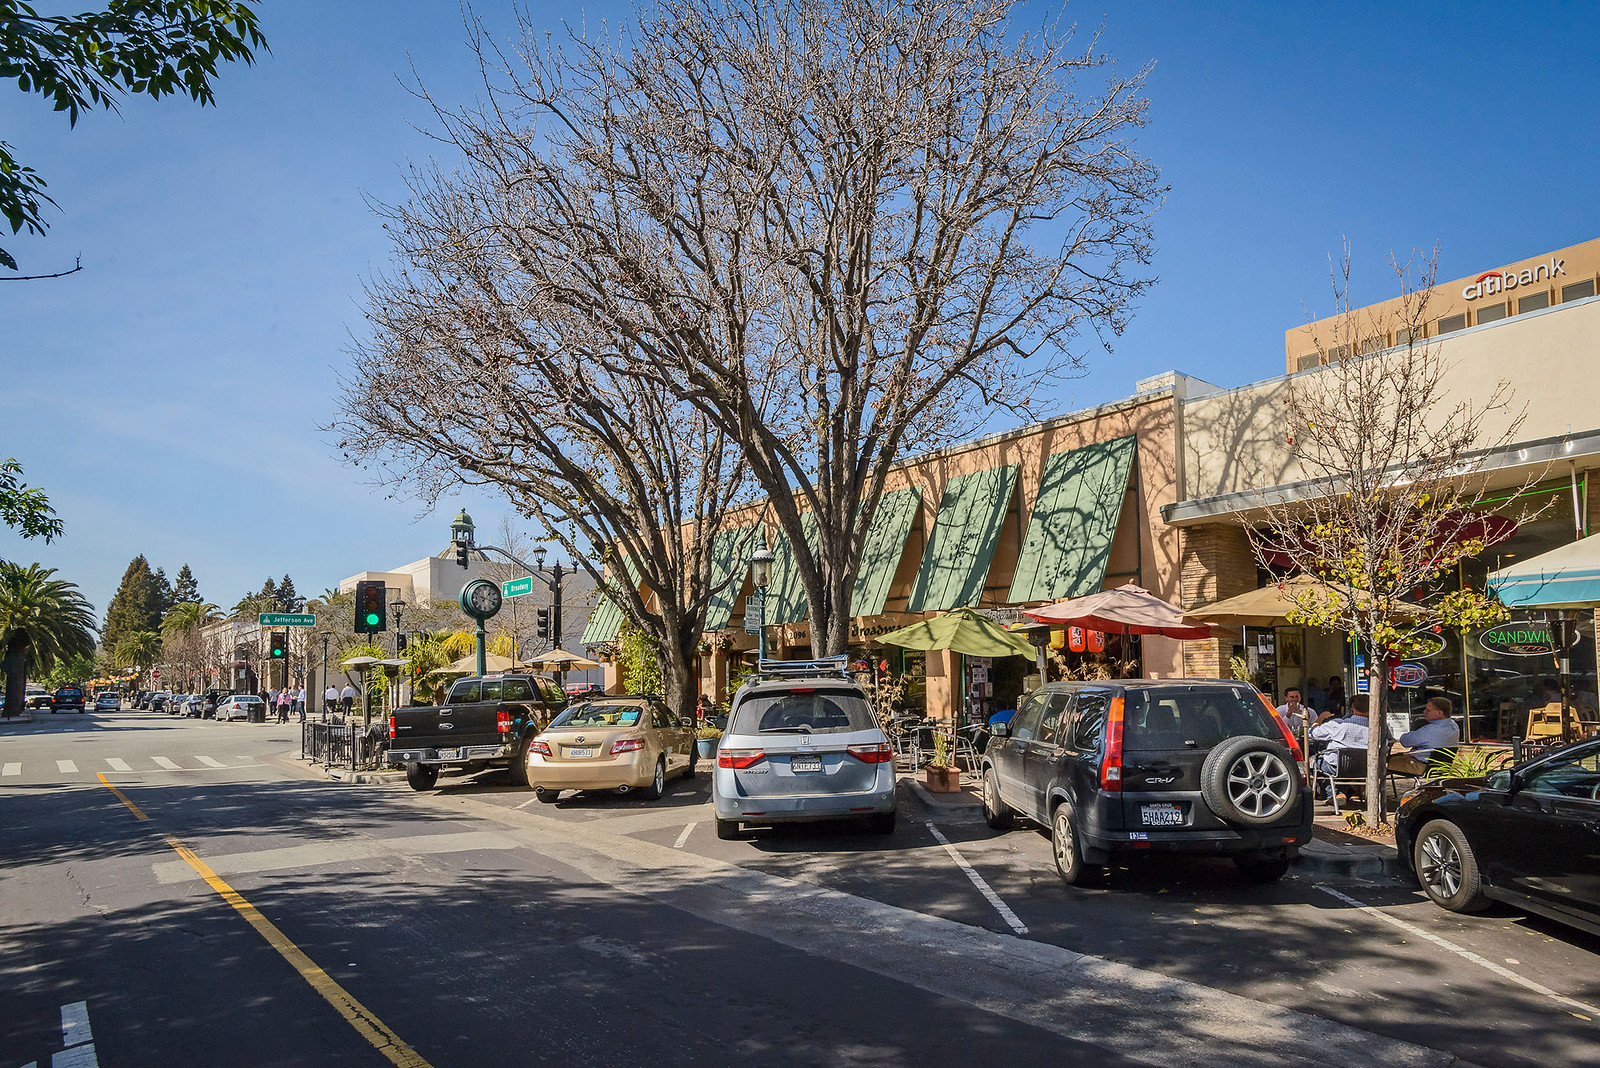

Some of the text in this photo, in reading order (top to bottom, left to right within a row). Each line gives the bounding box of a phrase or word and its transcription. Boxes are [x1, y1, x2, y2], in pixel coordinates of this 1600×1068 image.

[1462, 257, 1566, 300] citibank
[511, 584, 528, 592] Broadway
[789, 630, 806, 639] 2096
[1488, 630, 1555, 644] SANDWIC
[1143, 811, 1180, 822] 5HAA219
